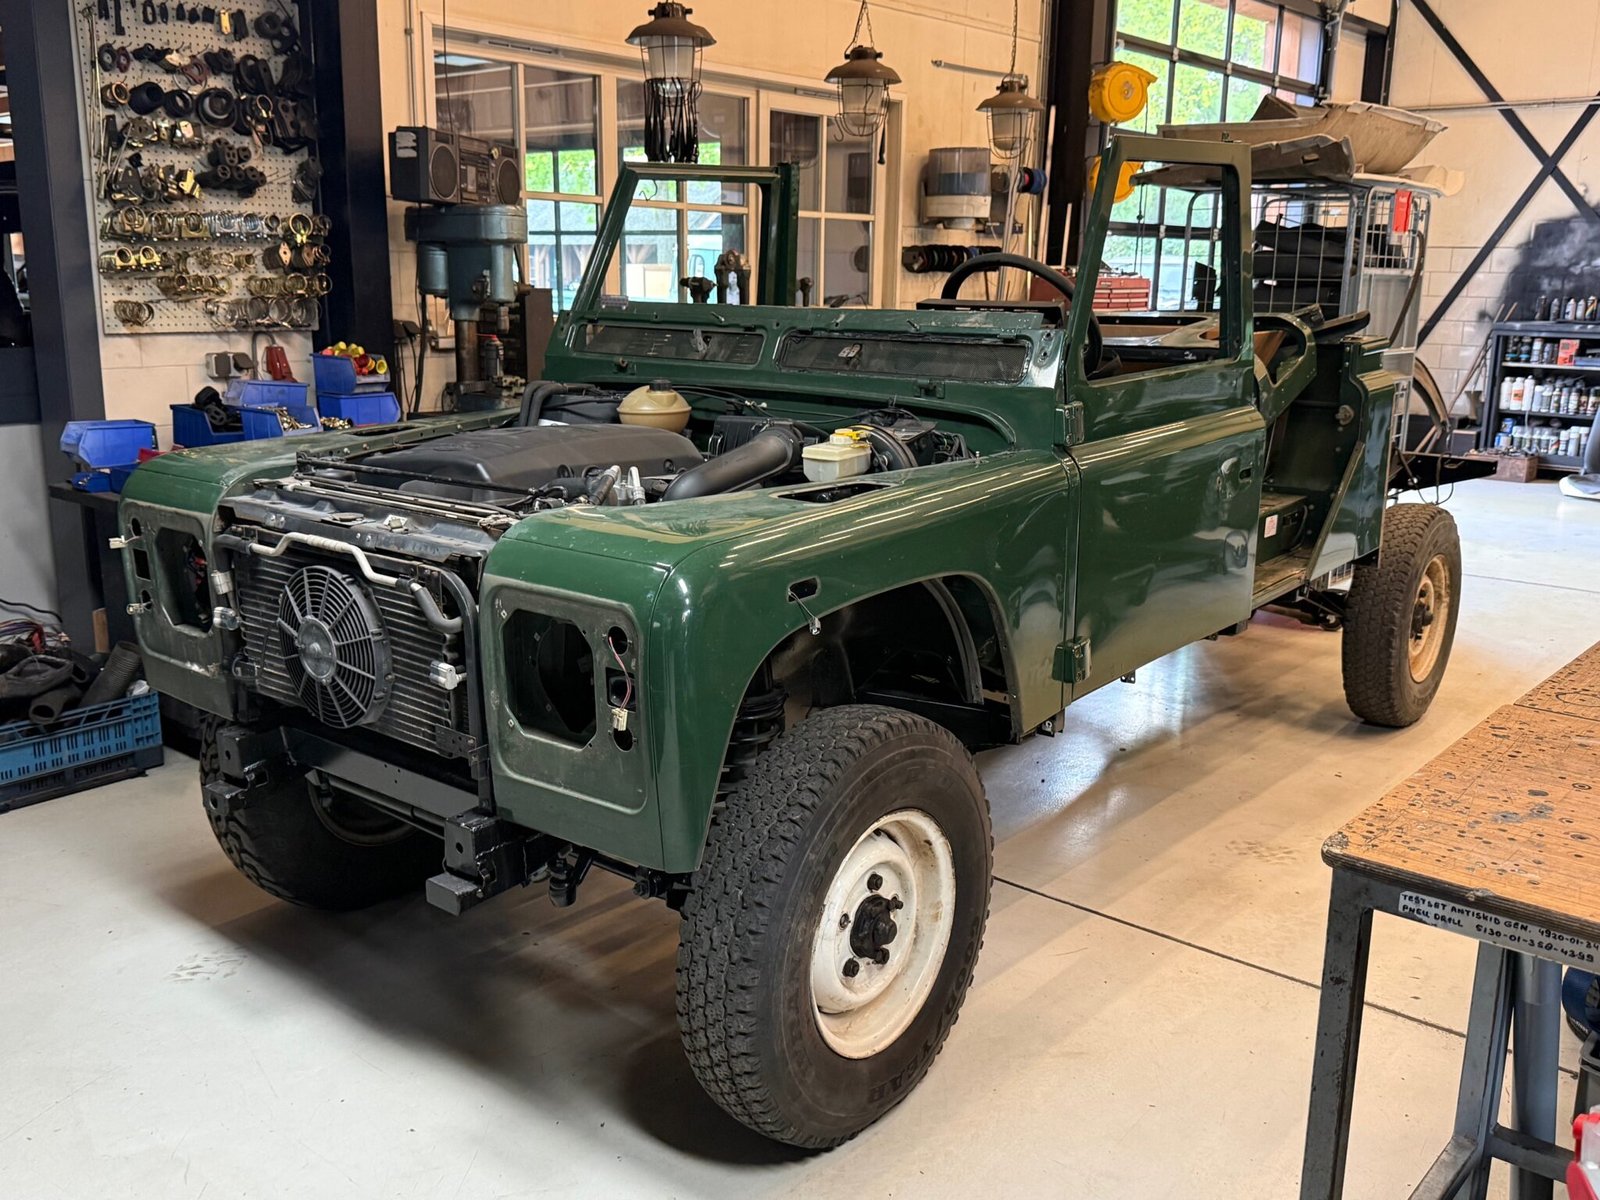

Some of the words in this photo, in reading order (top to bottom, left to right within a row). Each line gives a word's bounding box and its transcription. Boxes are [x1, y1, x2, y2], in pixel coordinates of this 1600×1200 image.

[1402, 904, 1430, 919] PNEU
[1434, 913, 1463, 928] DRILL
[1450, 906, 1500, 925] ANTISKID
[1504, 920, 1532, 934] GEN.
[867, 915, 980, 1104] GOODYEAR
